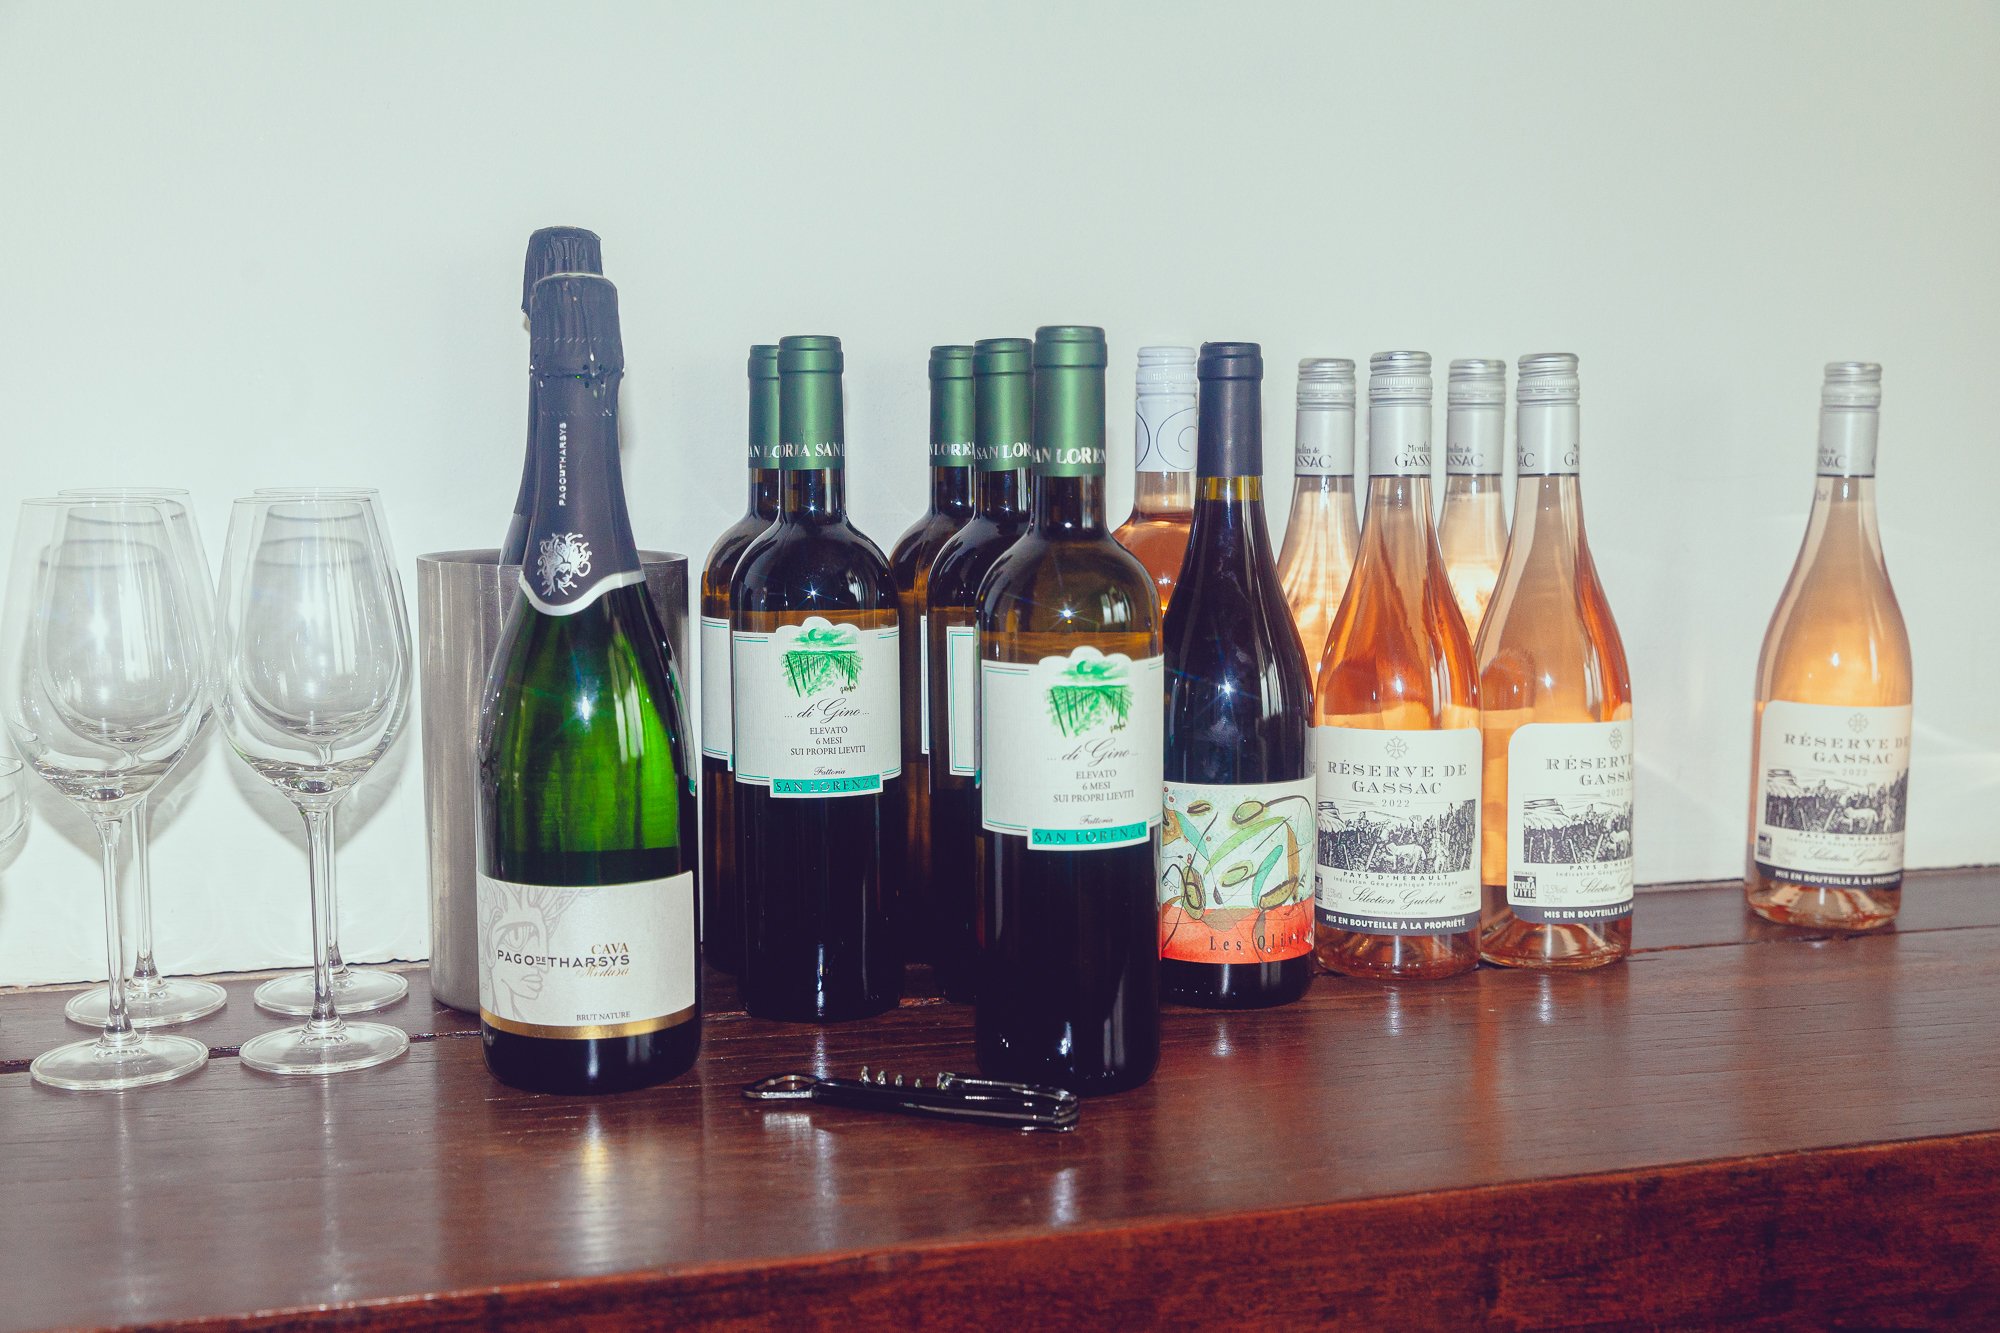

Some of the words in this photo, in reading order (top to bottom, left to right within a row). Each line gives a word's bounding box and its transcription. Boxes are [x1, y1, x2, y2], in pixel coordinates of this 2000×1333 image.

[809, 725, 848, 735] ELEVATO
[822, 736, 843, 745] MESI
[1784, 732, 1889, 749] RÉSERVE
[790, 748, 804, 756] SUI
[806, 746, 837, 756] PROPRI
[838, 744, 866, 755] LIEVITI
[1812, 752, 1893, 765] GASSAC
[813, 765, 847, 776] Fattoria
[1075, 769, 1117, 780] ELEVATO
[1327, 759, 1434, 778] RÉSERVE
[1443, 763, 1467, 777] DE
[775, 780, 803, 792] SAN
[809, 776, 880, 793] LORENZO
[1082, 782, 1088, 790] 6
[1089, 781, 1111, 790] MESI
[1351, 780, 1442, 794] GASSAC
[1053, 793, 1069, 803] SUI
[1071, 791, 1105, 803] PROPRI
[1106, 789, 1135, 801] LIEVITI
[1381, 798, 1410, 808] 2022
[1079, 814, 1114, 825] Fattoria
[1033, 830, 1067, 844] SAN
[1075, 824, 1146, 843] LORENZO
[1343, 871, 1370, 880] PAYS
[1790, 872, 1802, 881] EN
[1803, 873, 1852, 886] BOUTEILLE
[1861, 875, 1872, 886] LA
[1513, 881, 1536, 890] TERRA
[1398, 887, 1446, 910] Guibert
[1513, 889, 1537, 898] VITIS
[1544, 910, 1560, 919] MIS
[1562, 910, 1576, 919] EN
[1578, 908, 1618, 919] BOUTEILLE
[1325, 913, 1337, 924] MIS
[1338, 915, 1349, 925] EN
[1350, 918, 1398, 930] BOUTEILLE
[1410, 921, 1422, 930] LA
[1424, 917, 1466, 930] PROPRIÉTÉ
[591, 942, 629, 955] CAVA
[1210, 936, 1242, 951] Les
[576, 1013, 597, 1022] BRUT
[598, 1011, 631, 1021] NATURE
